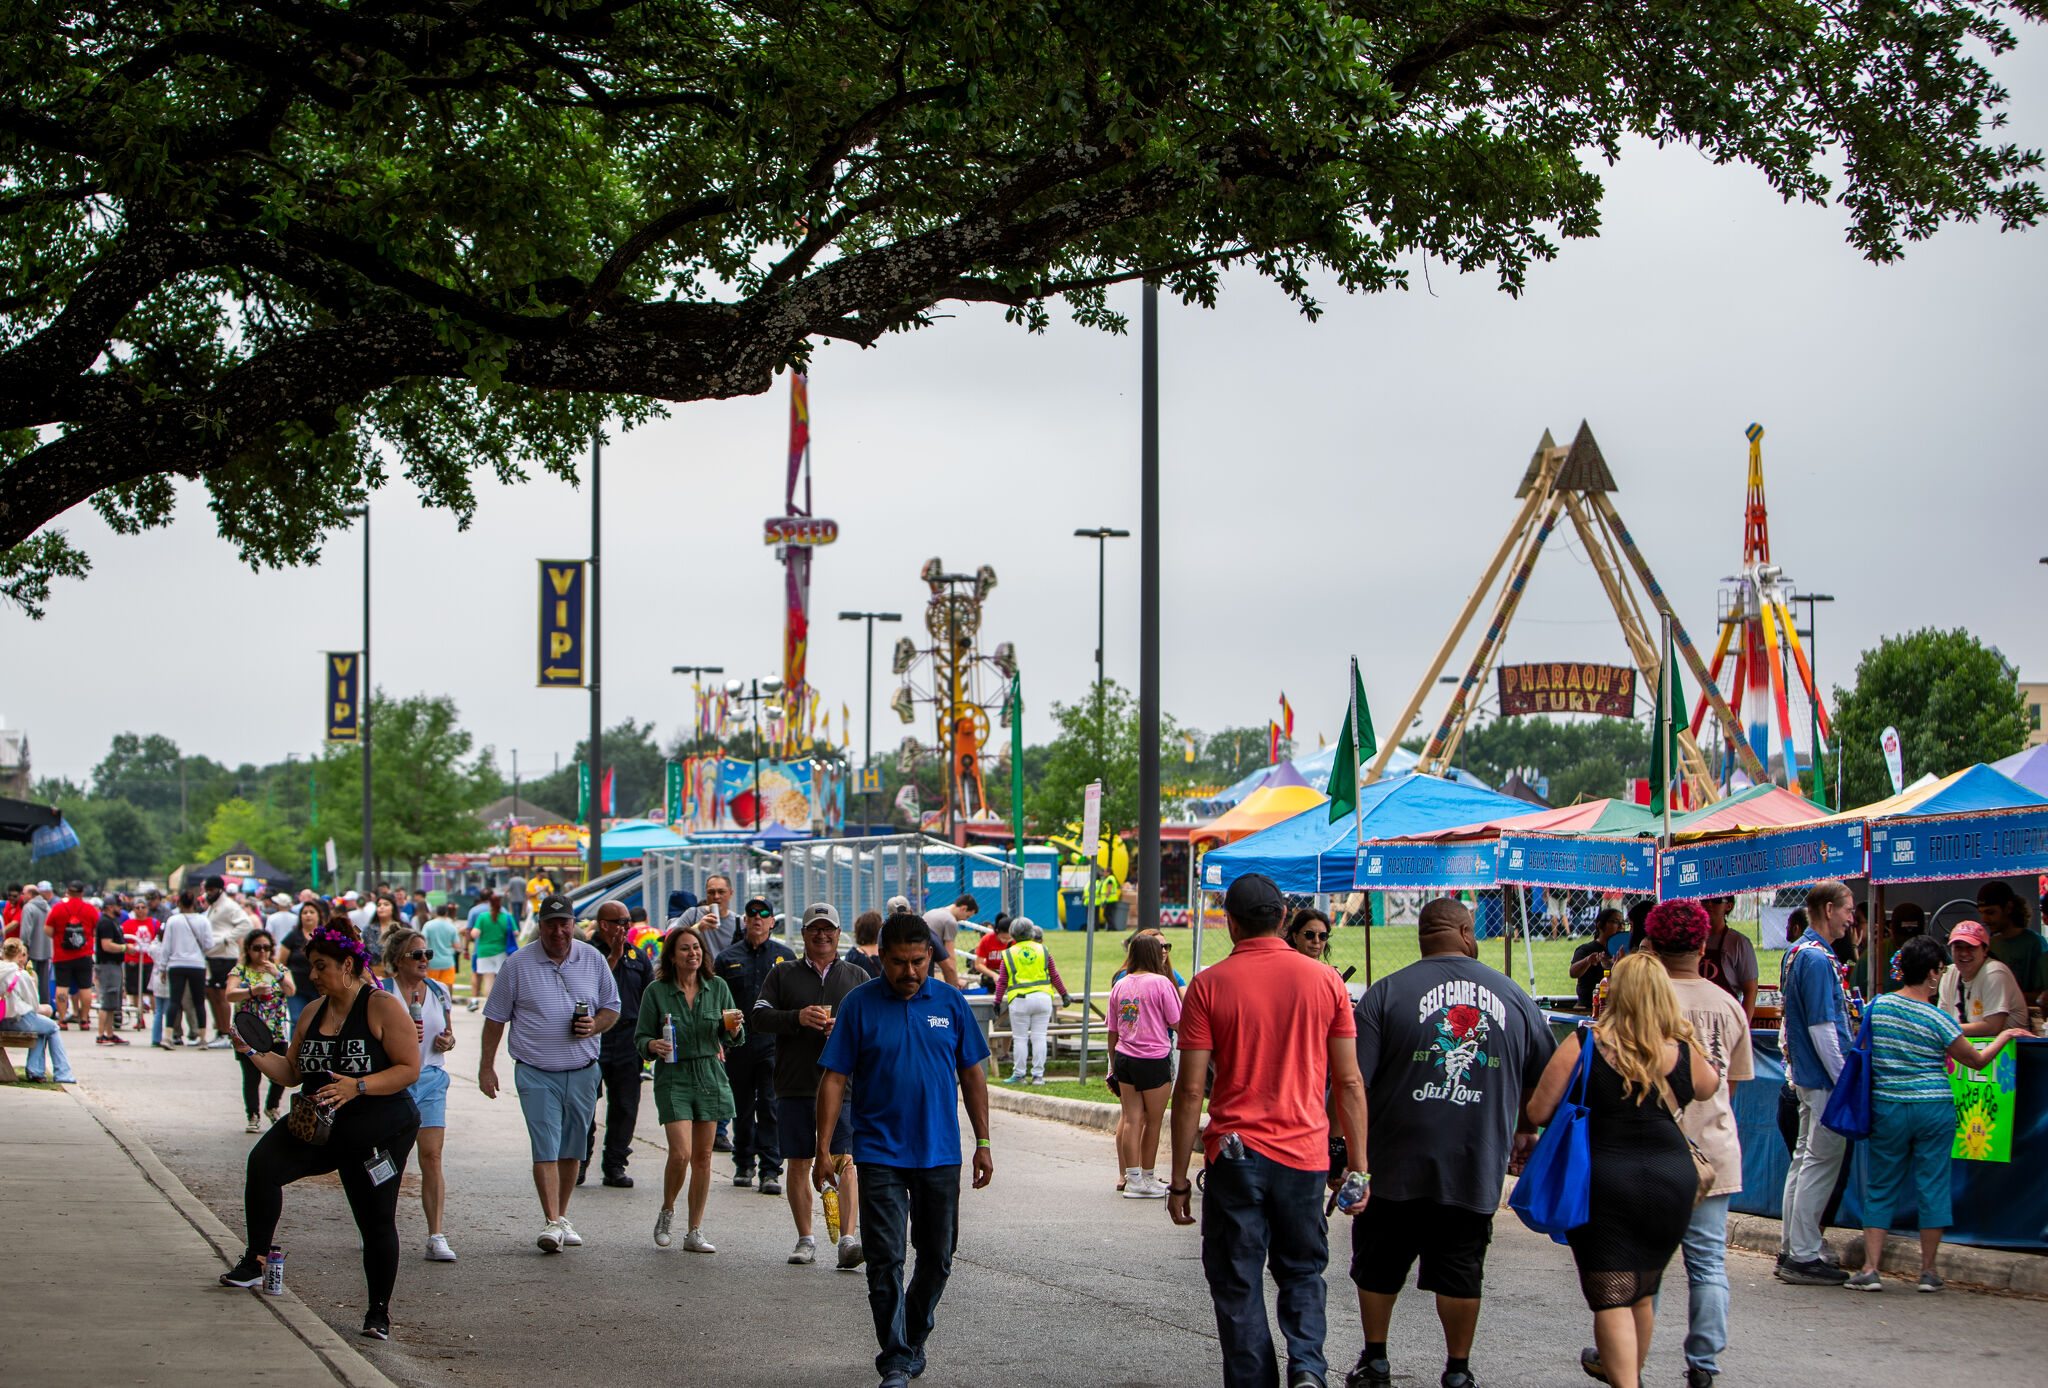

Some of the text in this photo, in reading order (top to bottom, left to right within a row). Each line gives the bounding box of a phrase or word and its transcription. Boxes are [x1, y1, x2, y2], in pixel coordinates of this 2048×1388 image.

[764, 517, 838, 546] SPEED
[548, 568, 576, 659] VIP
[1504, 663, 1630, 696] PHARAOH'S
[333, 657, 352, 722] VIP
[1535, 692, 1602, 712] FURY
[1511, 850, 1523, 859] BUD
[1895, 840, 1911, 851] BUD
[1929, 834, 1960, 862] FRITO
[1964, 832, 1982, 860] PIE
[1993, 830, 1998, 857] 4
[1371, 858, 1381, 866] BUD
[1387, 856, 1414, 874] ROASTED
[1416, 856, 1434, 874] CORN
[1445, 855, 1474, 874] COUPONS
[1509, 858, 1524, 868] LIGHT
[1528, 850, 1549, 870] AGUAS
[1550, 851, 1577, 872] FRESCAS
[1588, 853, 1618, 875] COUPONS
[1704, 857, 1724, 880] PINK
[1726, 849, 1768, 877] LEMONADE
[1781, 841, 1818, 868] COUPONS
[1893, 850, 1915, 862] LIGHT
[1368, 865, 1382, 874] LIGHT
[1679, 872, 1699, 884] LIGHT
[1681, 863, 1696, 874] BUD
[1419, 980, 1506, 1031] SELF CARE CLUB
[348, 1040, 364, 1055] &
[1412, 1051, 1431, 1062] EST
[268, 1270, 276, 1291] PWR
